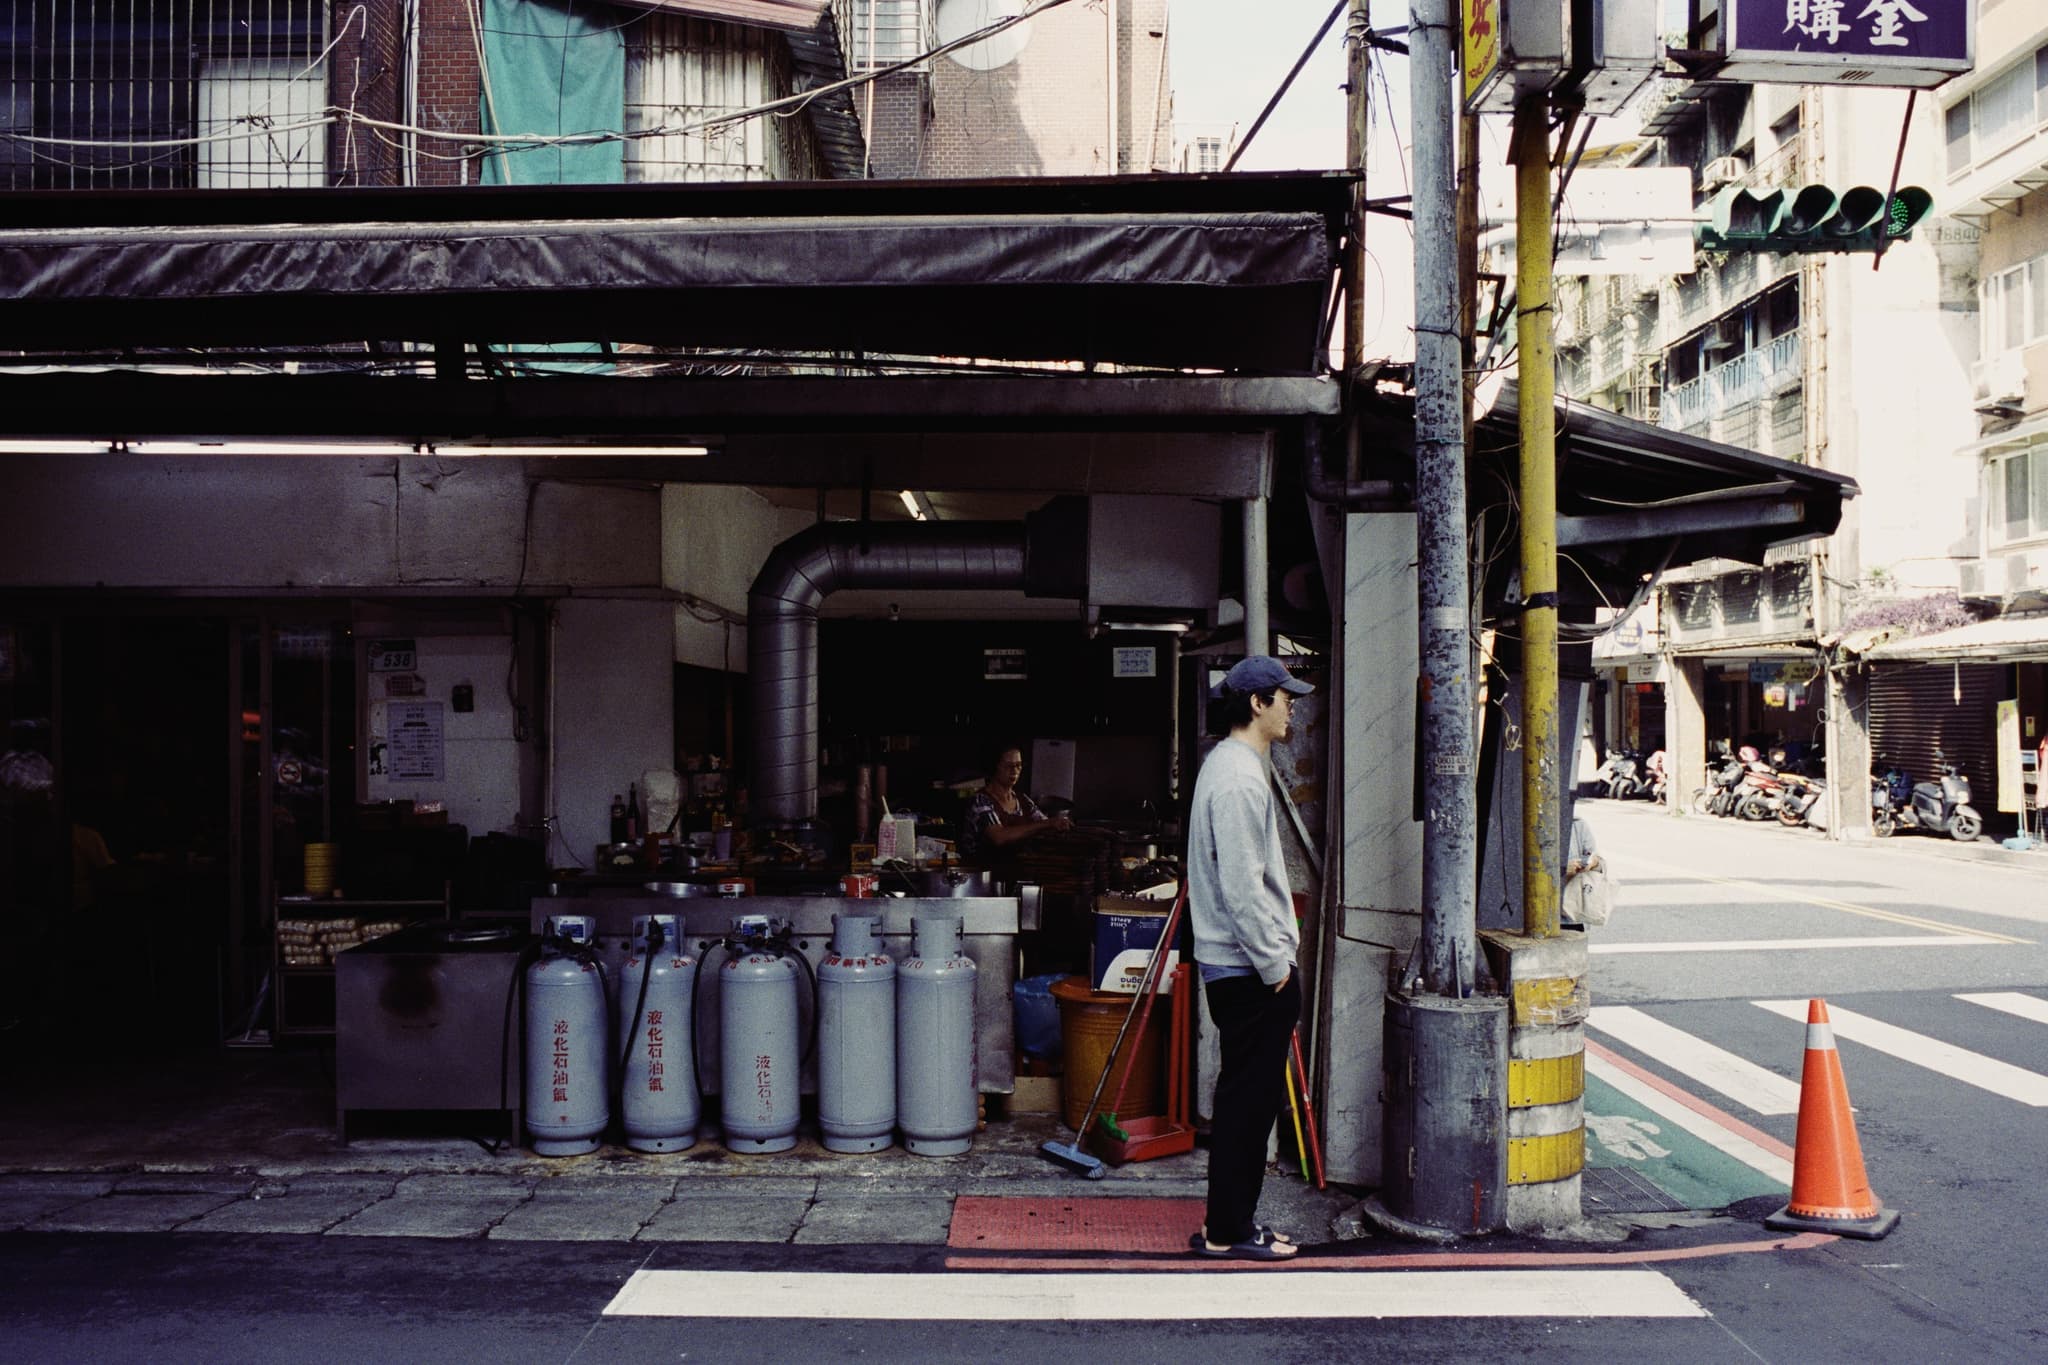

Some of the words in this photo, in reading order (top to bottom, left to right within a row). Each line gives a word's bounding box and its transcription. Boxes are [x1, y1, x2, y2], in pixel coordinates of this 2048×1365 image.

[383, 653, 412, 668] 538
[553, 1020, 568, 1102] 液化石油氣
